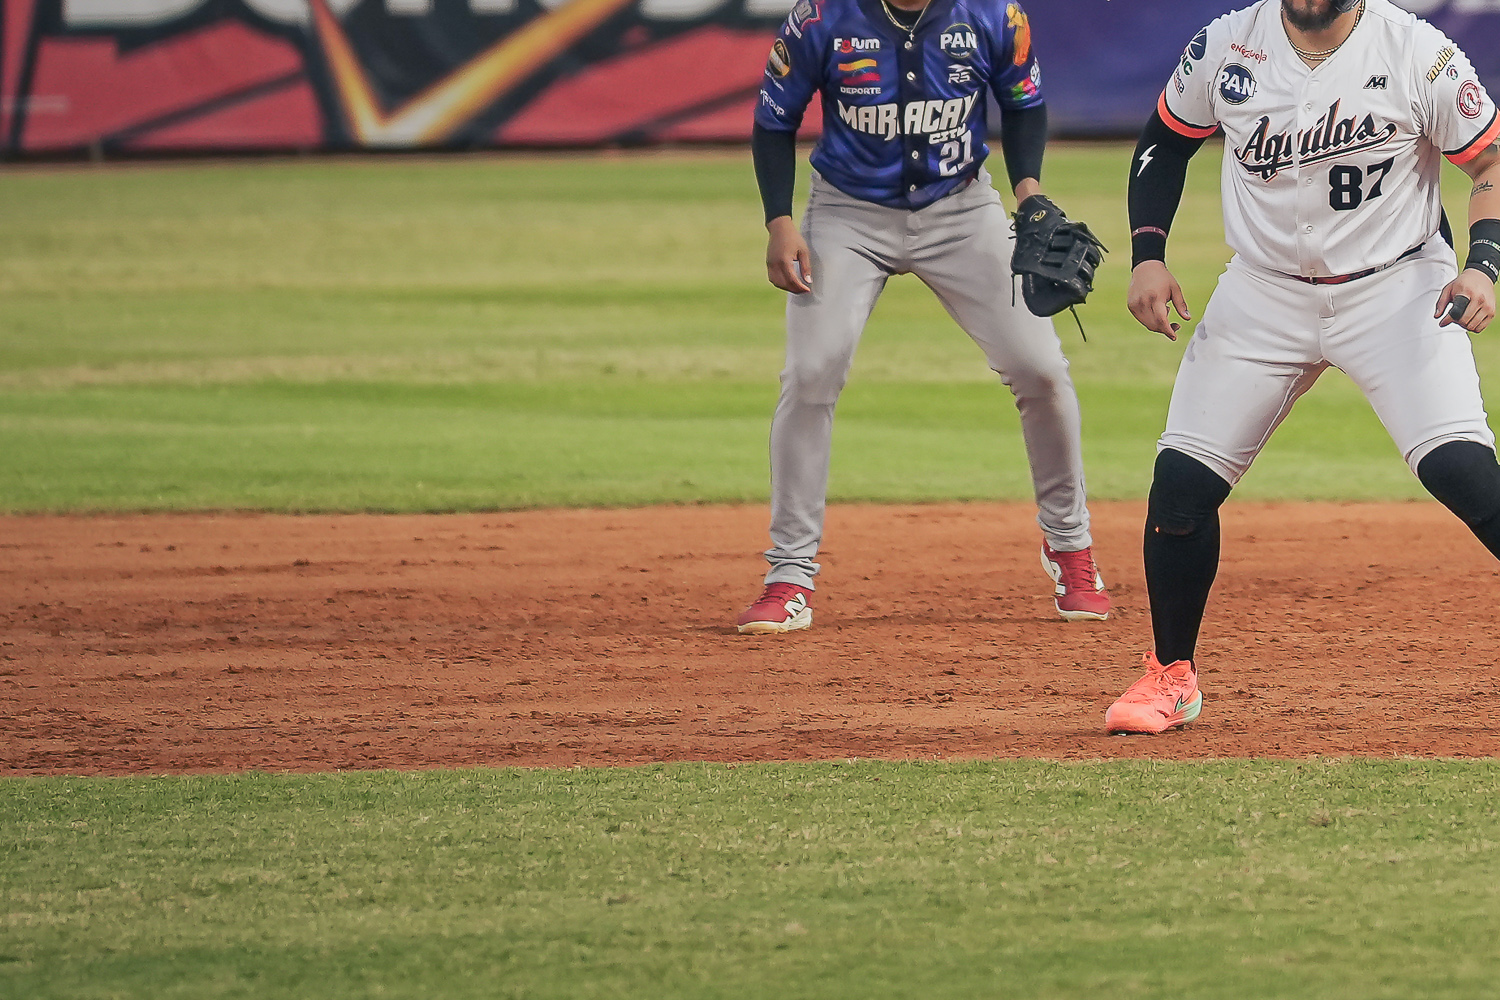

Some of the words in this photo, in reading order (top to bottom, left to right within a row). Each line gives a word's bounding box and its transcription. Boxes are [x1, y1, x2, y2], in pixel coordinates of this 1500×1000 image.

[840, 86, 882, 95] DEPORTE
[837, 90, 978, 141] MARACAY
[938, 129, 973, 176] 21
[1329, 157, 1394, 211] 87
